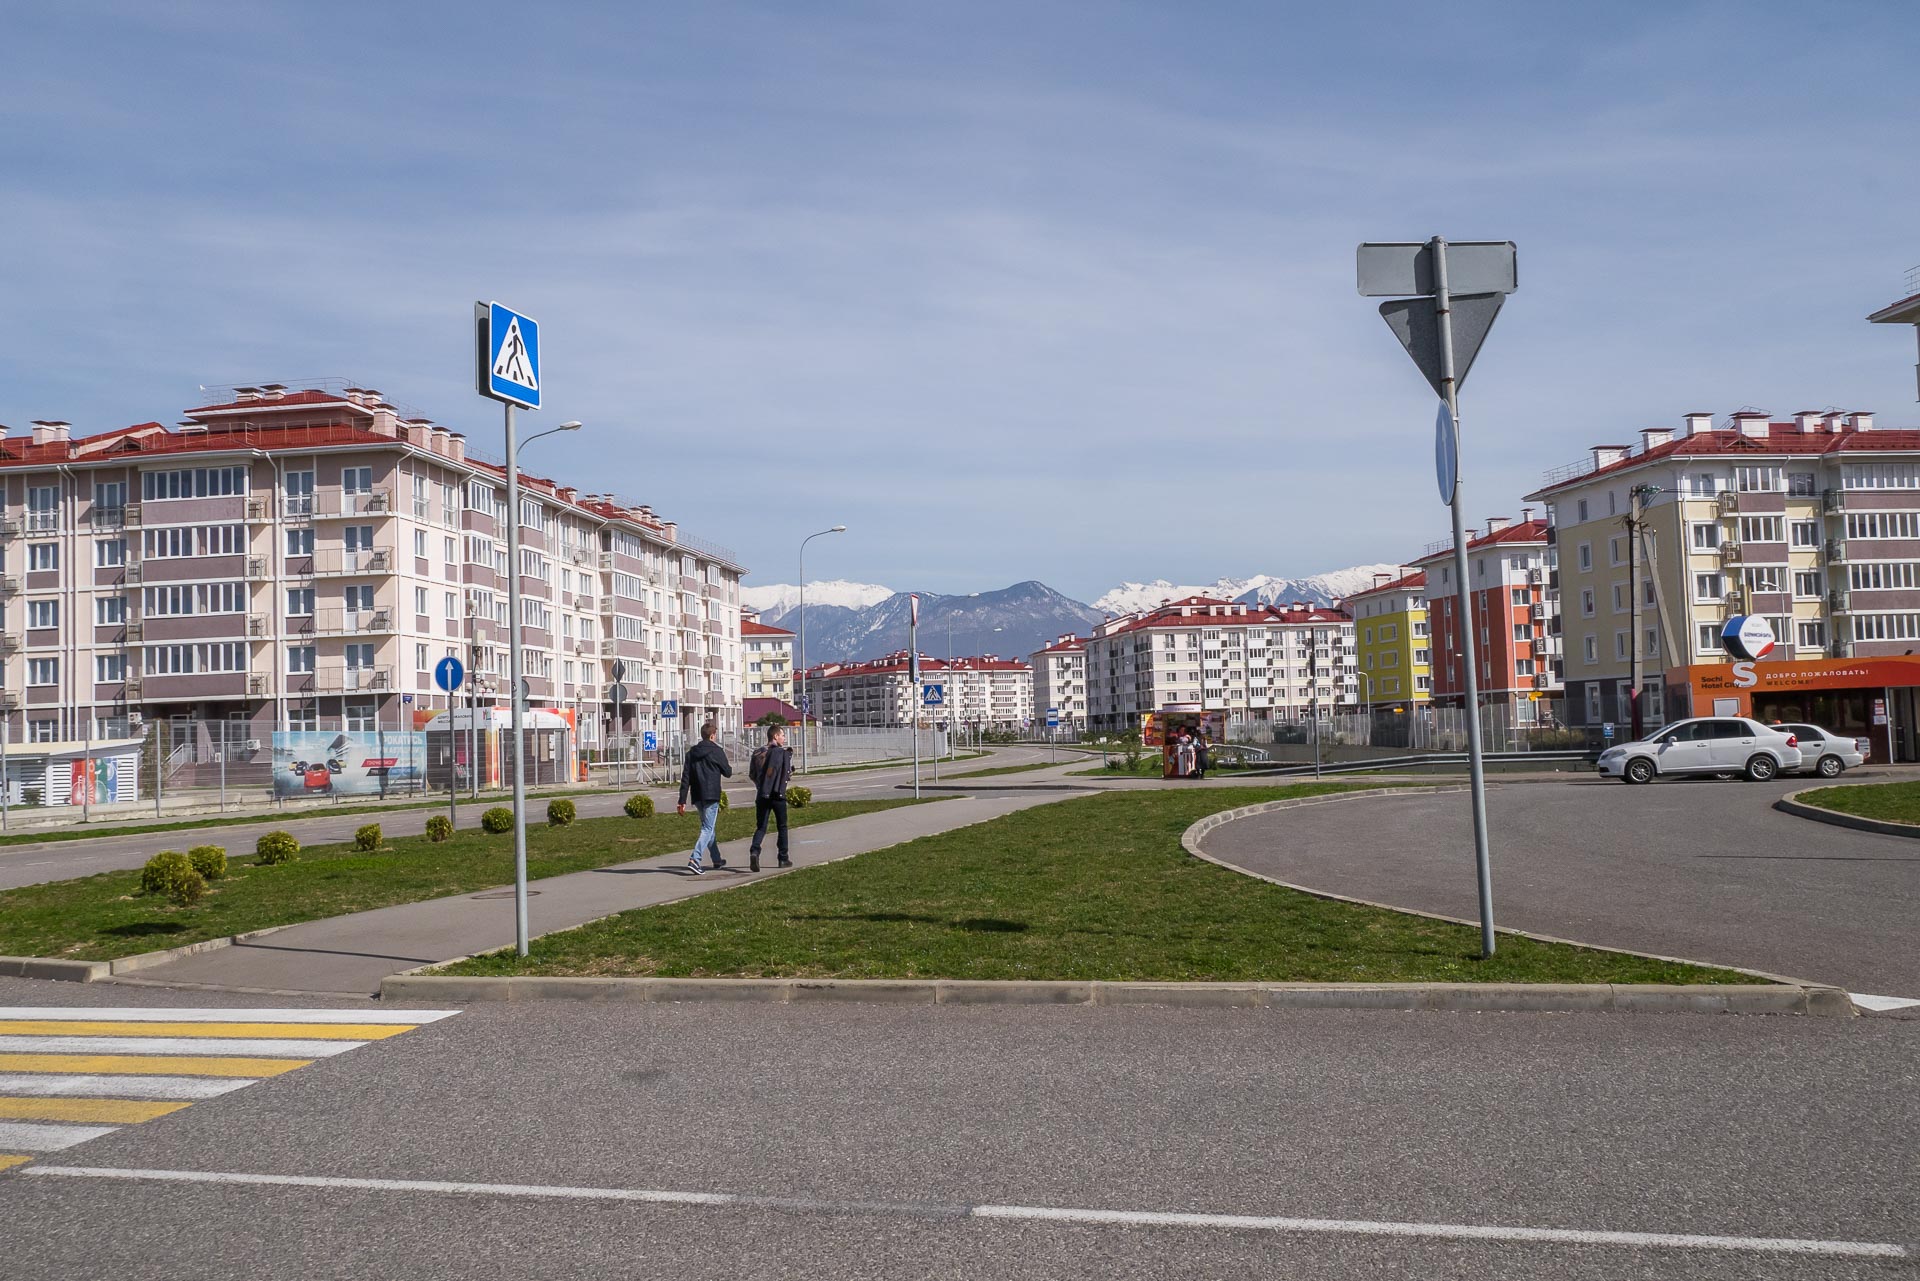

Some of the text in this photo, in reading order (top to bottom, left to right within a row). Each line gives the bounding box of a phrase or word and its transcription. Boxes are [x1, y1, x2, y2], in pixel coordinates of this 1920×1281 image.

[1732, 662, 1758, 687] S
[1765, 669, 1869, 680] ДОБРО ПОЖАЛОВАТЬ!
